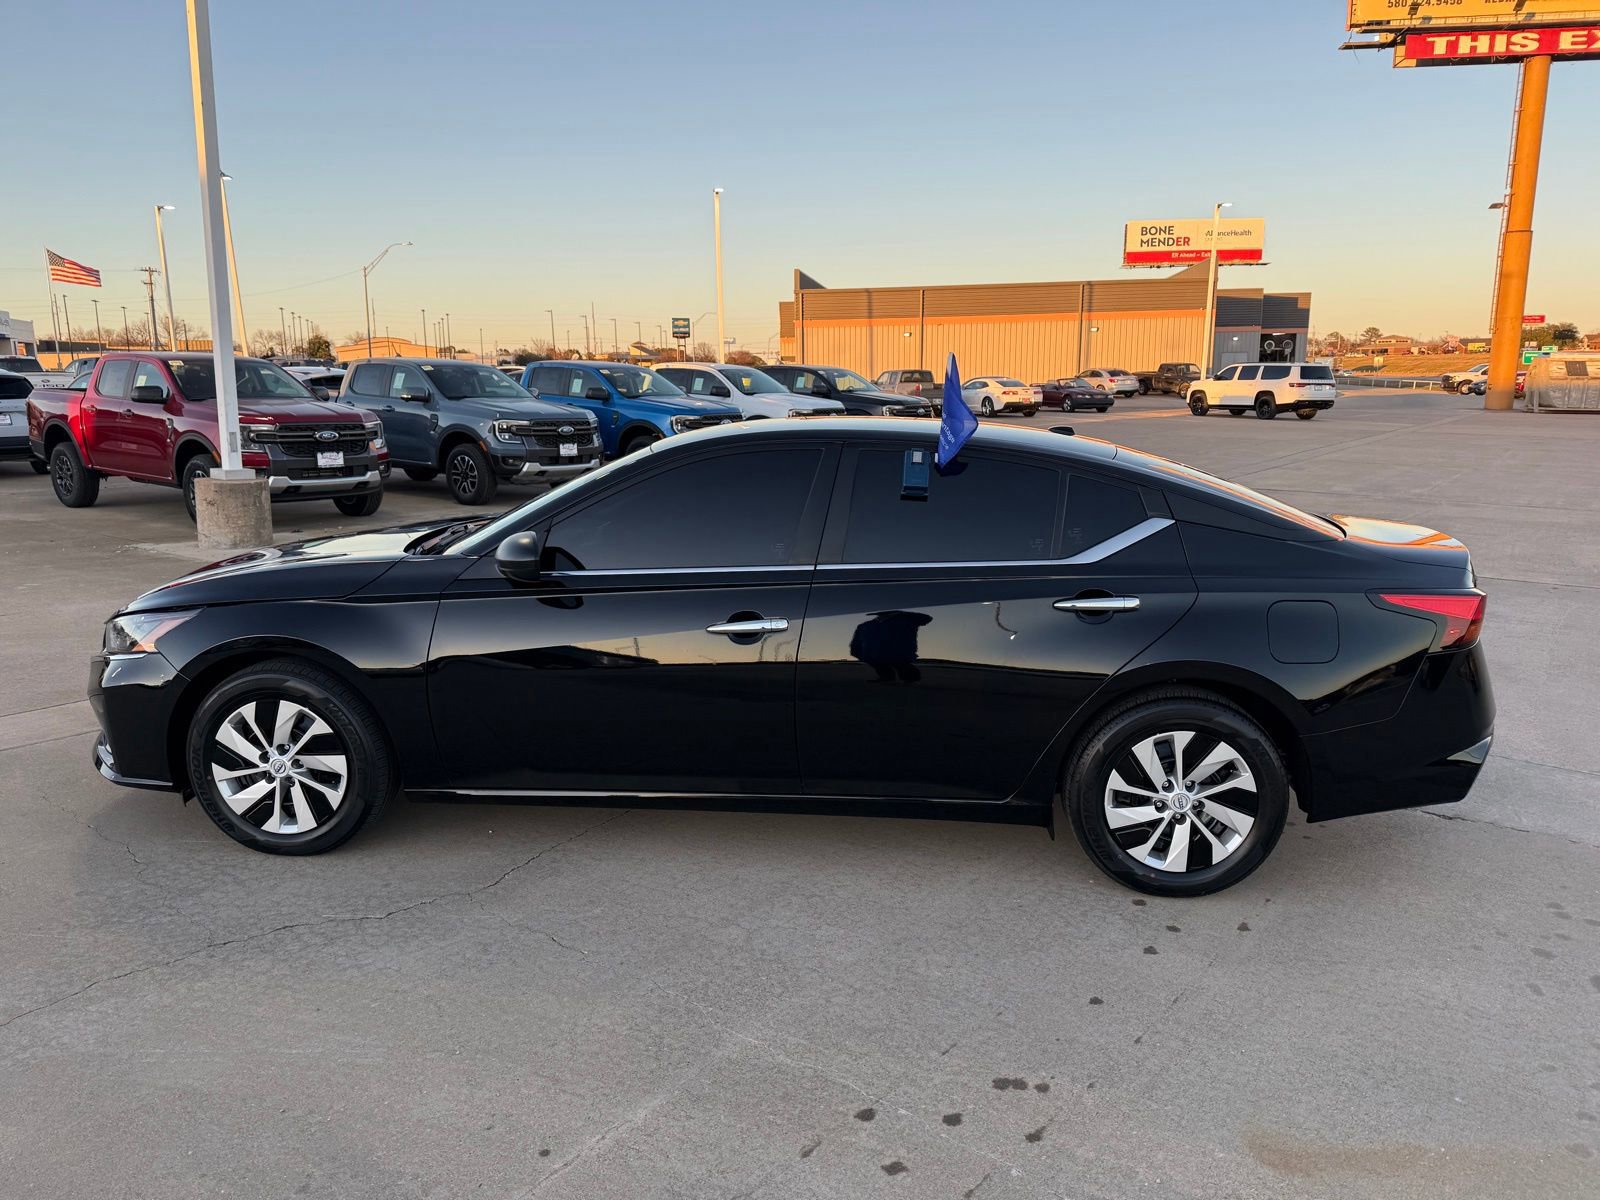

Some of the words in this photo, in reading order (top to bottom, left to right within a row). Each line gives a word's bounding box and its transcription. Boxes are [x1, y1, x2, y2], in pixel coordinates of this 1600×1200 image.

[1426, 32, 1541, 55] THIS
[1141, 225, 1175, 236] BONE
[1205, 229, 1252, 237] AlnceHealth
[1140, 236, 1191, 248] MENDER
